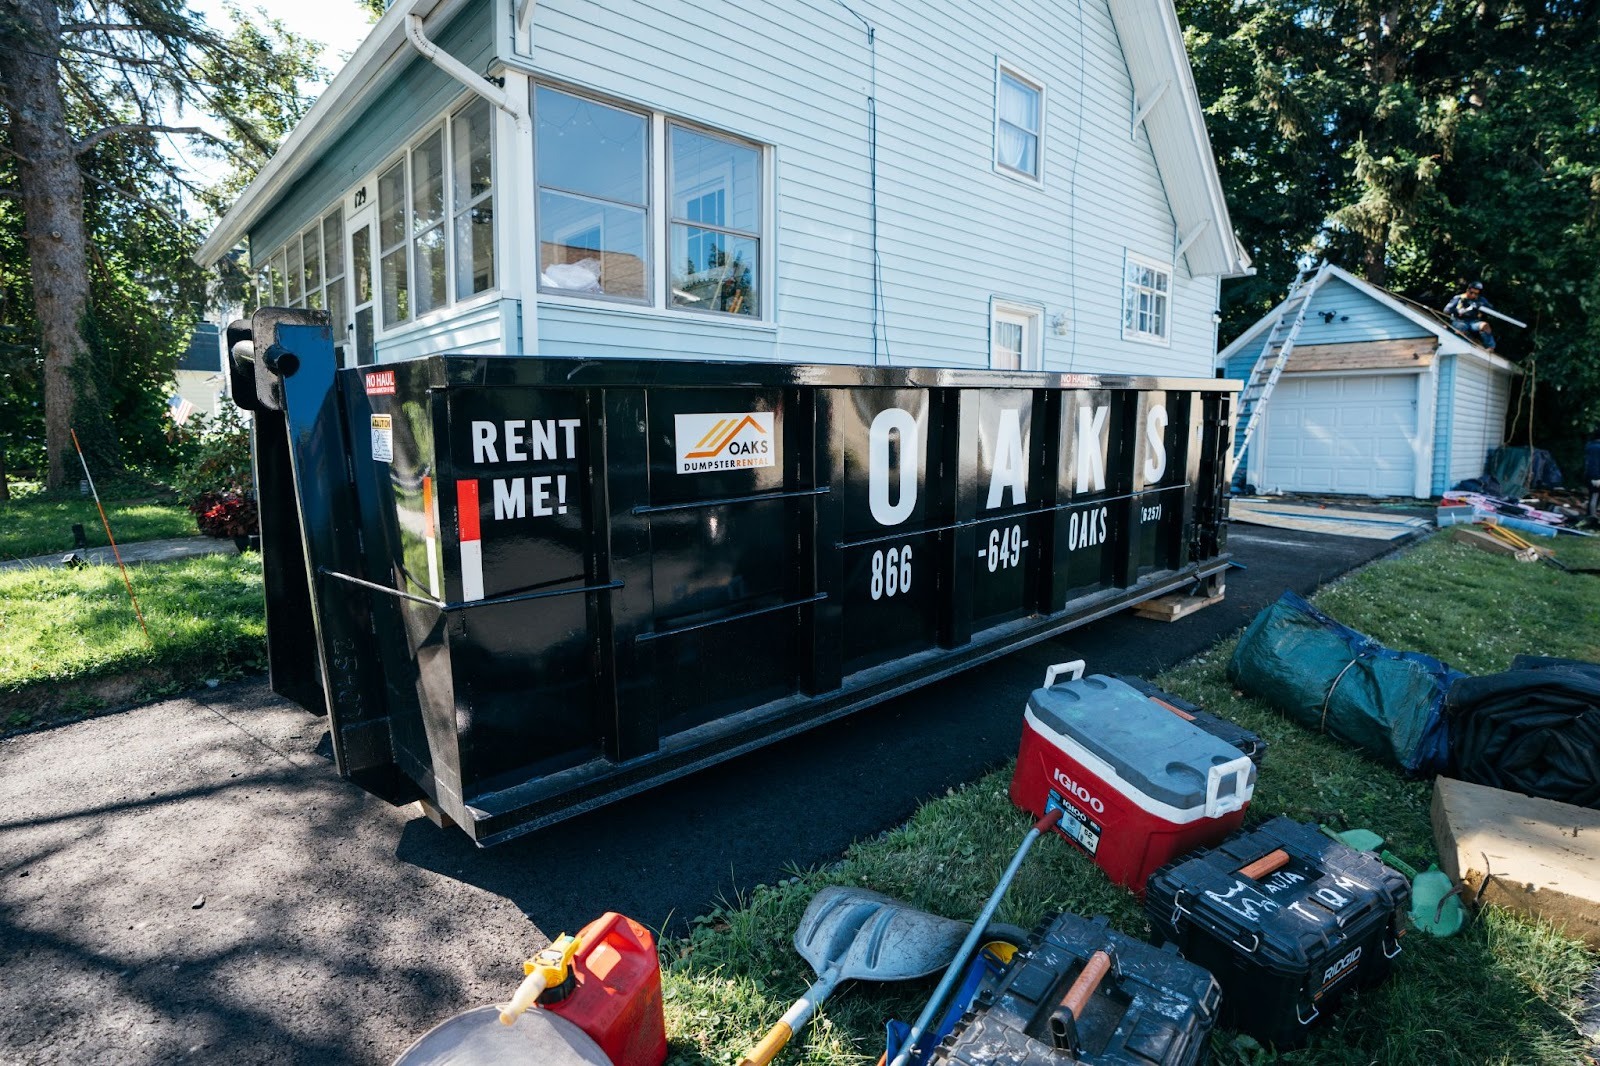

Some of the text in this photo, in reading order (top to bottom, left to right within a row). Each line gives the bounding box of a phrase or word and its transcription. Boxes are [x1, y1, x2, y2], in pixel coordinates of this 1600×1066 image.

[354, 187, 367, 208] 129
[366, 372, 395, 387] NO HAUL
[1061, 374, 1071, 382] NO
[471, 419, 581, 463] RENT
[729, 440, 768, 455] OAKS
[869, 404, 1168, 525] OAKS
[493, 475, 567, 520] ME!
[871, 545, 912, 600] 866
[1068, 506, 1107, 551] OAKS
[1141, 504, 1161, 524] (6257)
[1054, 768, 1104, 813] IGLOO
[1063, 799, 1087, 821] IGLOO
[1322, 946, 1362, 984] RIDGID
